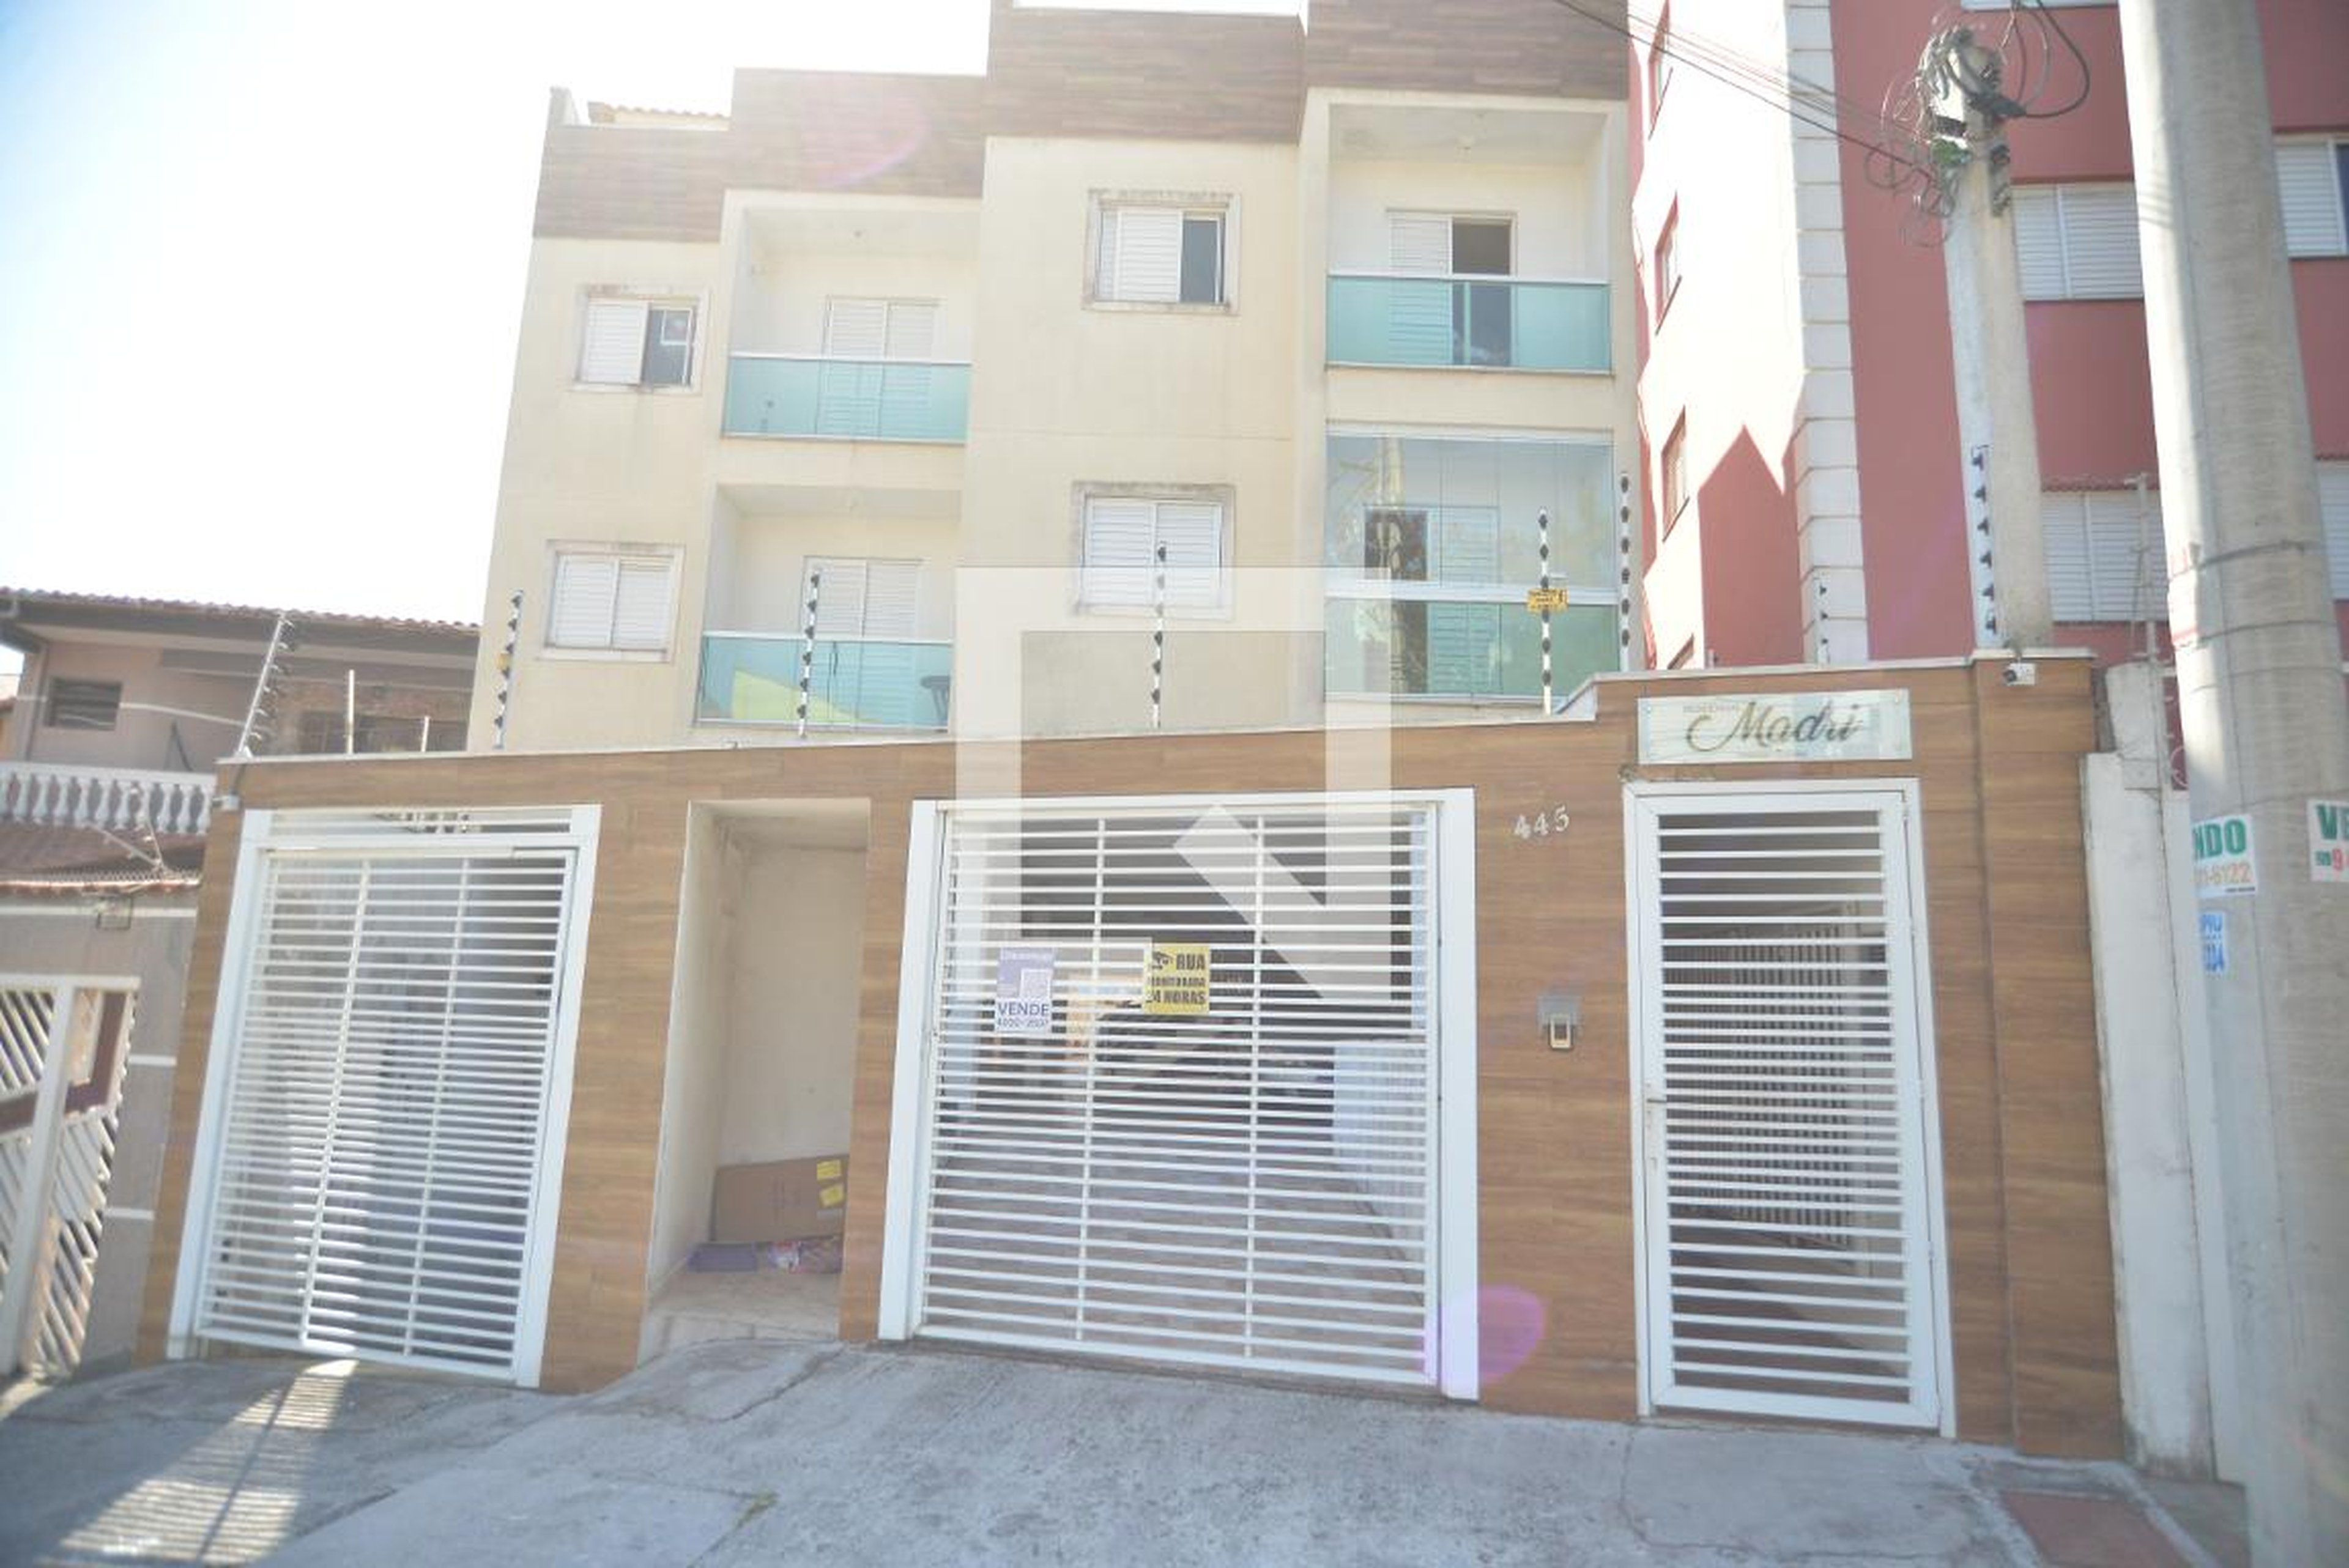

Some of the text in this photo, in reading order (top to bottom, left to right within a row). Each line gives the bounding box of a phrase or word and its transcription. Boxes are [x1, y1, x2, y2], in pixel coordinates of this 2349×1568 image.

[1176, 953, 1206, 971] RUA
[1163, 990, 1207, 1005] HORAS
[998, 1002, 1050, 1016] VENDE
